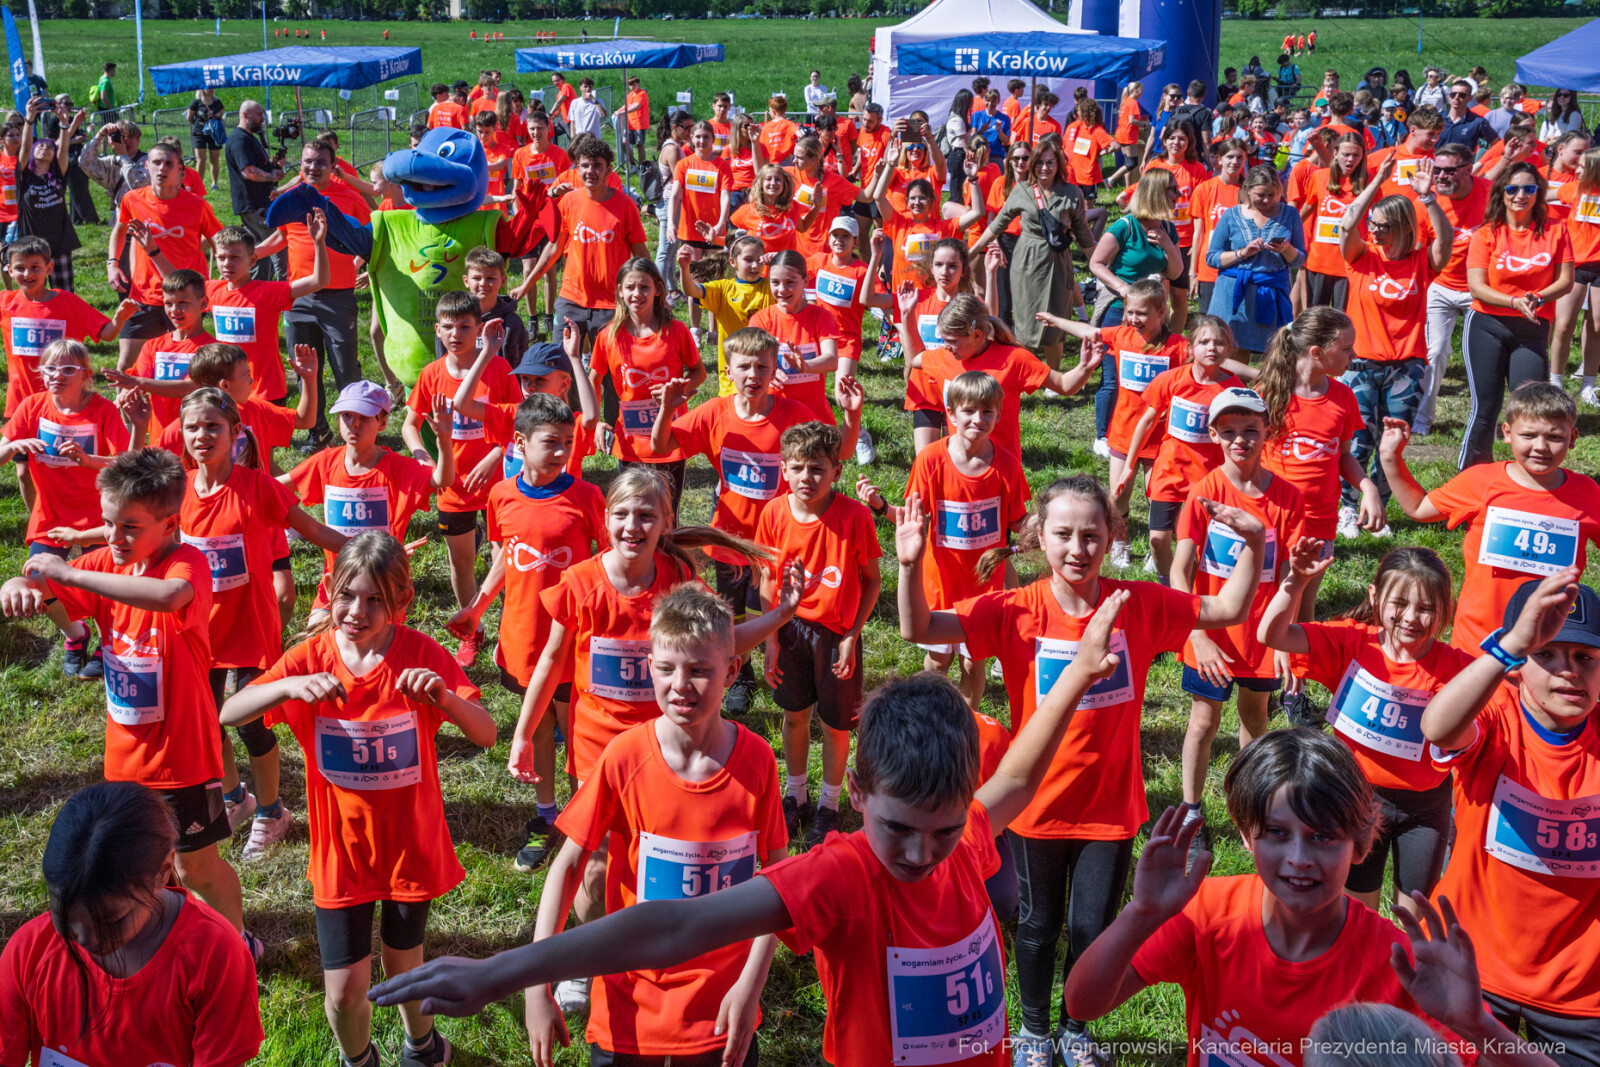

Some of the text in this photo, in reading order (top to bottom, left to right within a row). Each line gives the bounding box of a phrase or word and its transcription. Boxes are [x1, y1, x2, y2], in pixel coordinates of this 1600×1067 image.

[580, 51, 636, 65] Kraków
[988, 50, 1068, 71] Kraków
[232, 63, 301, 81] Kraków
[389, 57, 410, 75] Kraków
[1186, 411, 1209, 429] 61
[206, 550, 228, 571] 83
[391, 719, 411, 729] biegiem
[1367, 721, 1386, 733] SP 27
[729, 844, 750, 856] biegiem
[1551, 850, 1563, 858] SP
[901, 957, 944, 969] #ogarniam
[958, 1010, 982, 1027] SP 95
